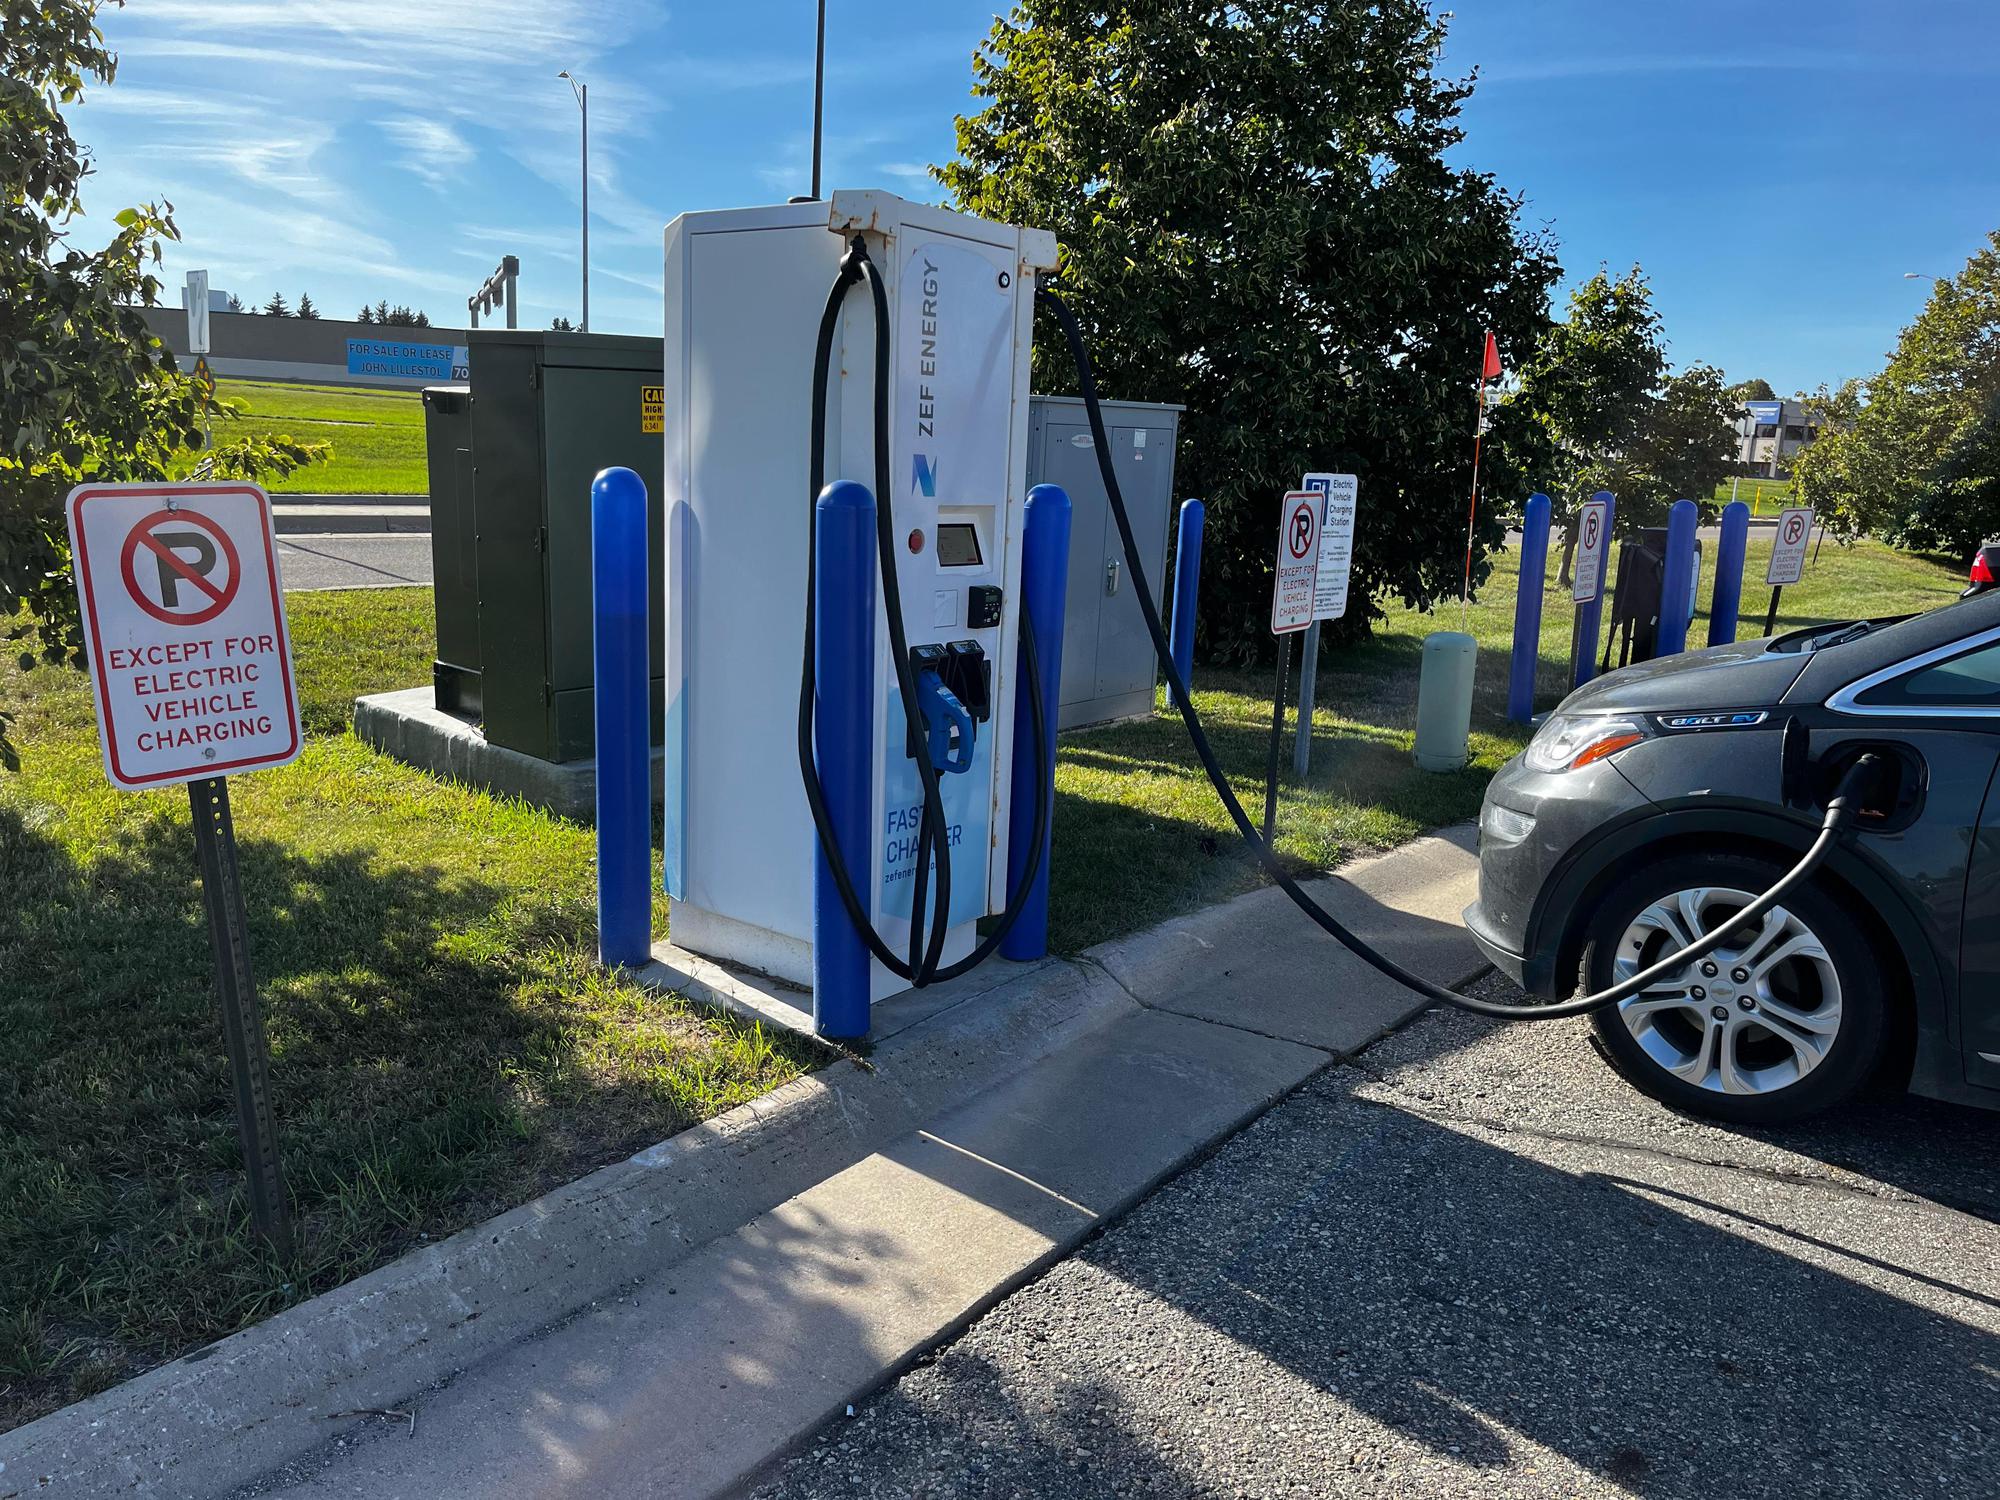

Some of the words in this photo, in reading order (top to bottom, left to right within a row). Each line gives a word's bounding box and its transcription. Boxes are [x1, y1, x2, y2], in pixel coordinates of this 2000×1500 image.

[920, 258, 939, 377] ENERGY
[349, 343, 370, 354] FOR
[373, 346, 399, 357] SALE
[402, 347, 417, 359] OR
[420, 349, 451, 360] LEASE
[360, 362, 388, 374] JOHN
[391, 364, 443, 377] LILLESTOL
[644, 405, 662, 414] HIGH
[918, 384, 934, 438] ZEF
[1333, 479, 1353, 489] Electric
[1333, 491, 1351, 501] Vehicle
[1330, 504, 1352, 516] Charging
[1330, 517, 1349, 526] Station
[1280, 566, 1302, 577] EXCEPT
[1304, 565, 1315, 574] FOR
[1283, 578, 1309, 590] ELECTRIC
[1283, 592, 1307, 603] VEHICLE
[1280, 604, 1308, 617] CHARGING
[109, 641, 214, 670] EXCEPT
[224, 634, 274, 657] FOR
[134, 663, 260, 697] ELECTRIC
[144, 690, 258, 723] VEHICLE
[1672, 716, 1727, 726] BOLT
[1731, 714, 1760, 723] EV
[137, 716, 272, 752] CHARGING
[888, 805, 924, 834] FAS
